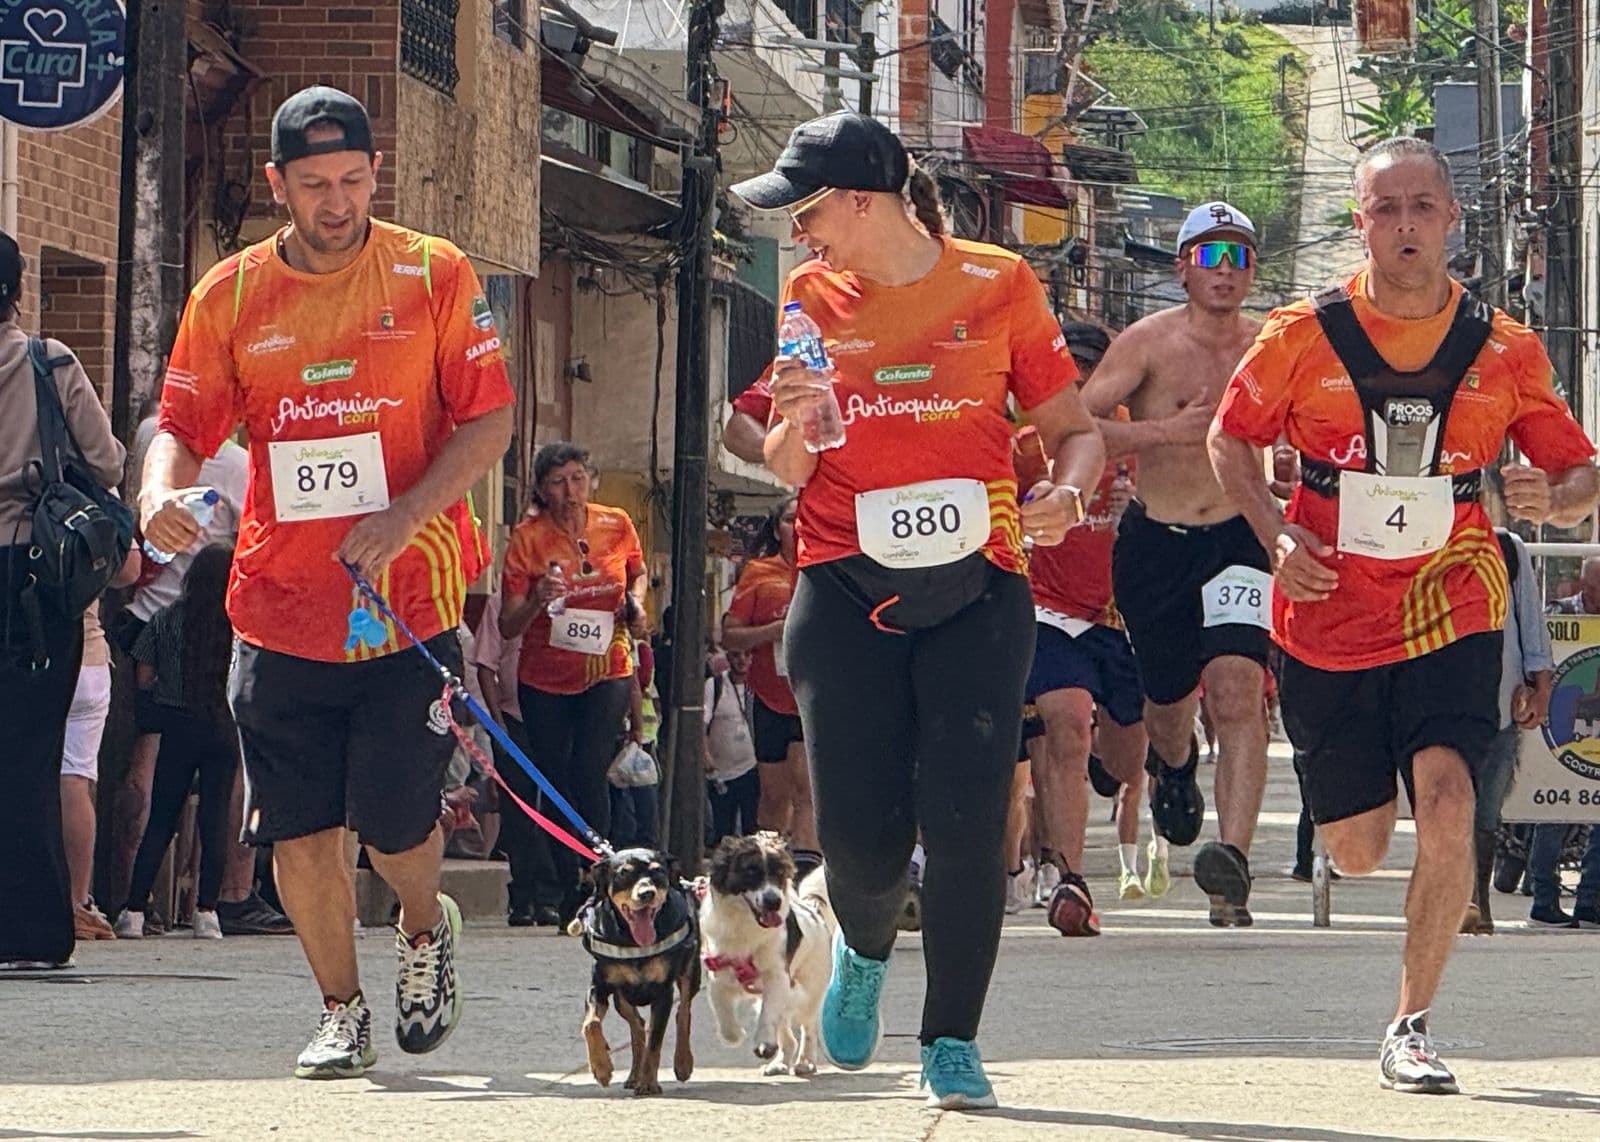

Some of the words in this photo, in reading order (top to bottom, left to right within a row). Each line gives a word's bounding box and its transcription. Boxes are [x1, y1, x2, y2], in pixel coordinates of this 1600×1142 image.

[5, 46, 78, 76] Cura
[271, 391, 403, 435] Antioquia
[841, 393, 984, 426] Antioquia
[920, 411, 961, 422] corre
[1388, 403, 1434, 417] PROOS
[297, 461, 358, 492] 879
[891, 503, 961, 539] 880
[1385, 504, 1408, 533] 4
[1218, 585, 1262, 608] 378
[566, 622, 602, 641] 894
[1546, 621, 1580, 641] SOLO
[1533, 789, 1571, 805] 604
[1578, 789, 1600, 805] 86
